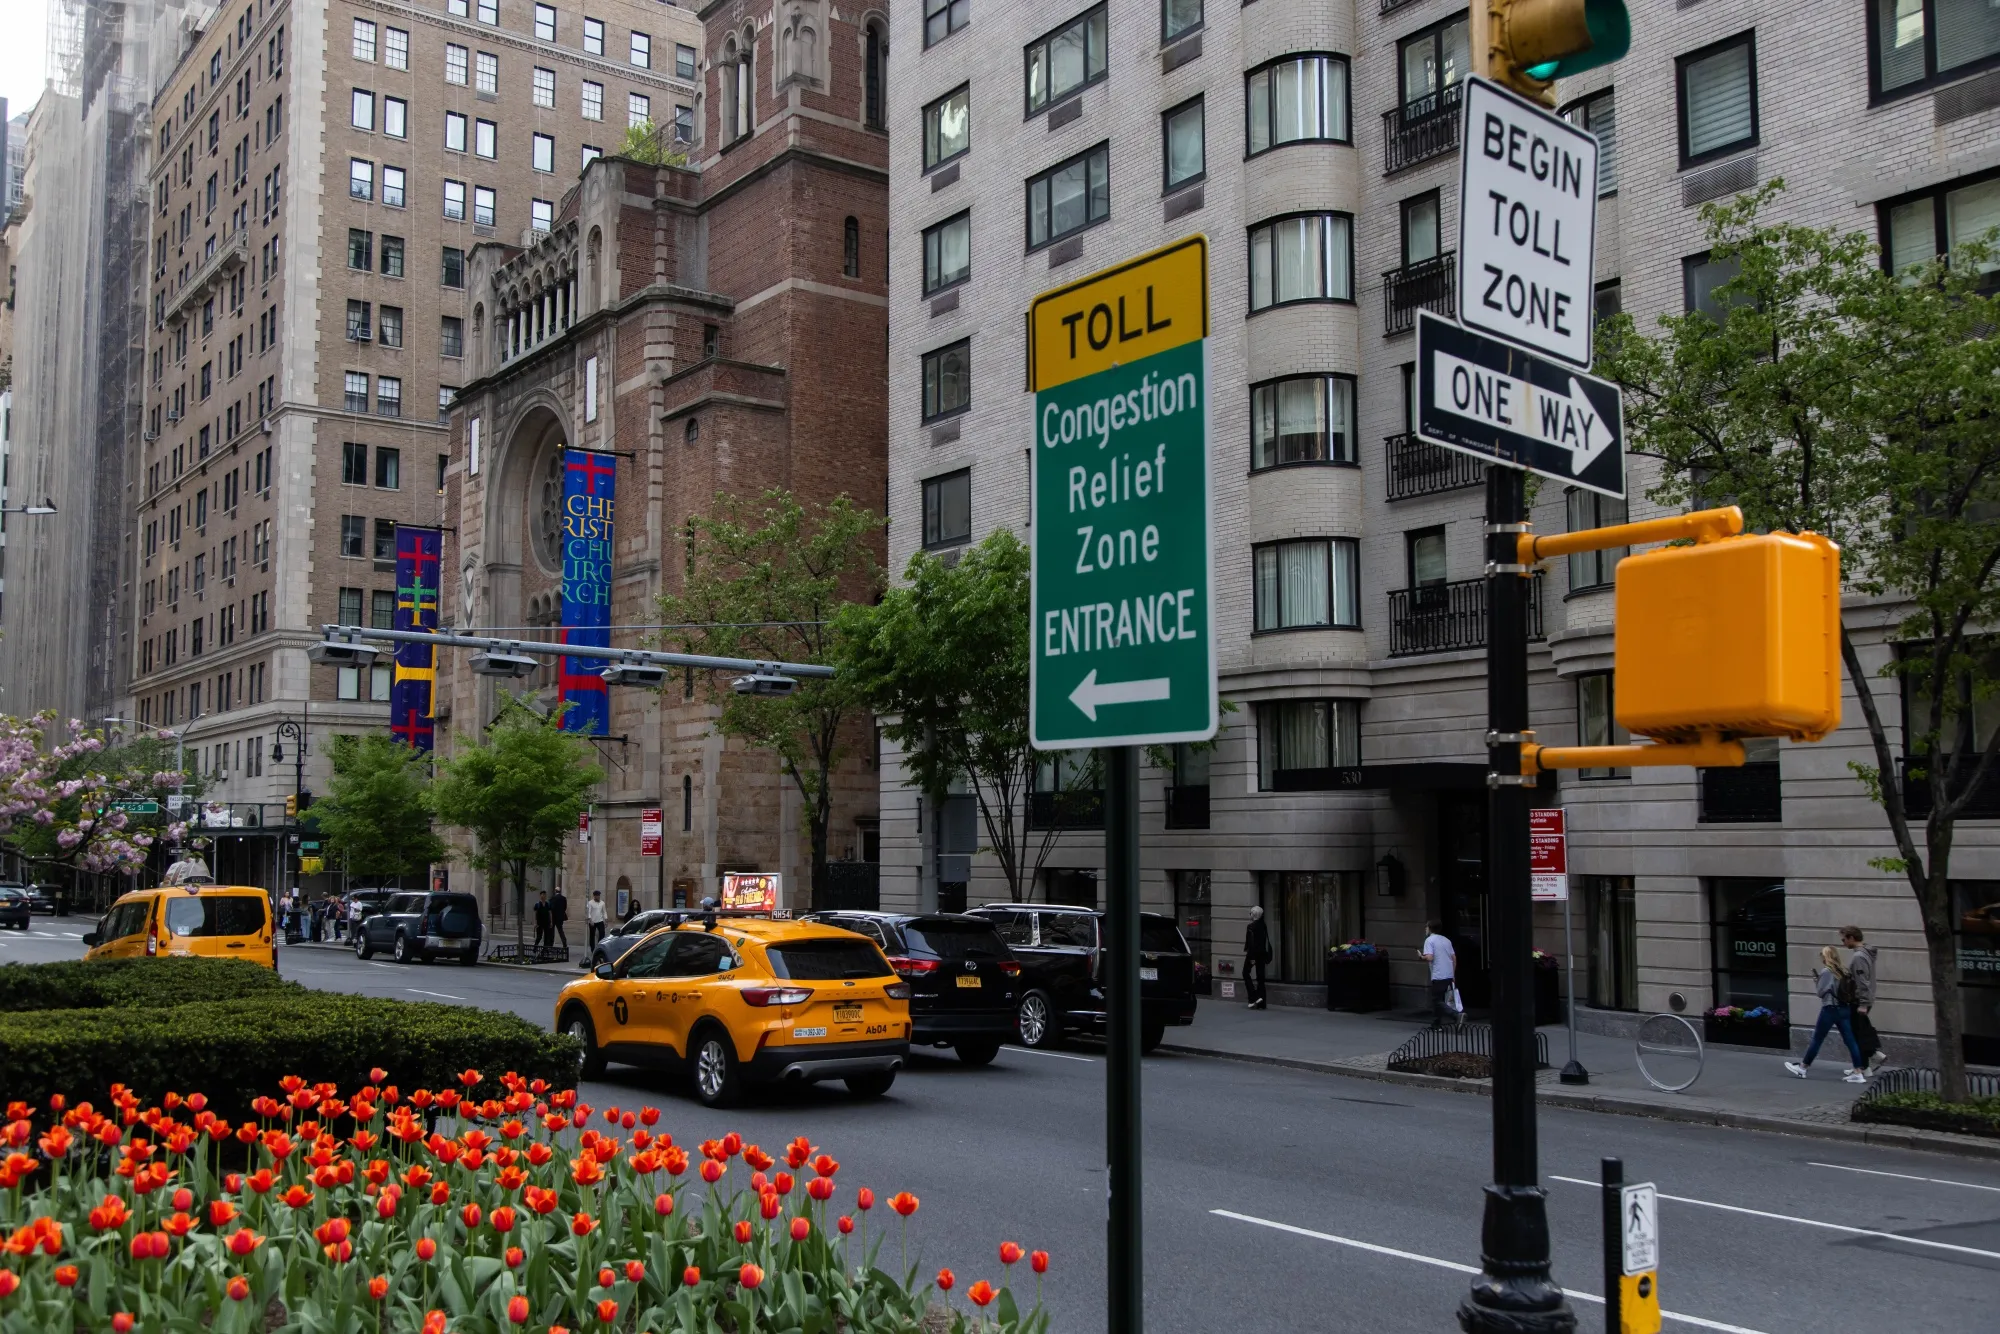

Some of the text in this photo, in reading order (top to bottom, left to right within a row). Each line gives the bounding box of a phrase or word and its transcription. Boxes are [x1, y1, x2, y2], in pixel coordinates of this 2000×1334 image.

[1484, 112, 1581, 199] BEGIN
[1489, 189, 1570, 266] TOLL
[1062, 285, 1172, 359] TOLL
[1483, 263, 1571, 337] ZONE
[1043, 371, 1197, 449] Congestion
[1453, 365, 1594, 450] ONE WAY
[1069, 443, 1166, 513] Relief
[1075, 524, 1160, 574] Zone
[1044, 588, 1197, 657] ENTRANCE
[773, 910, 790, 919] 9H54
